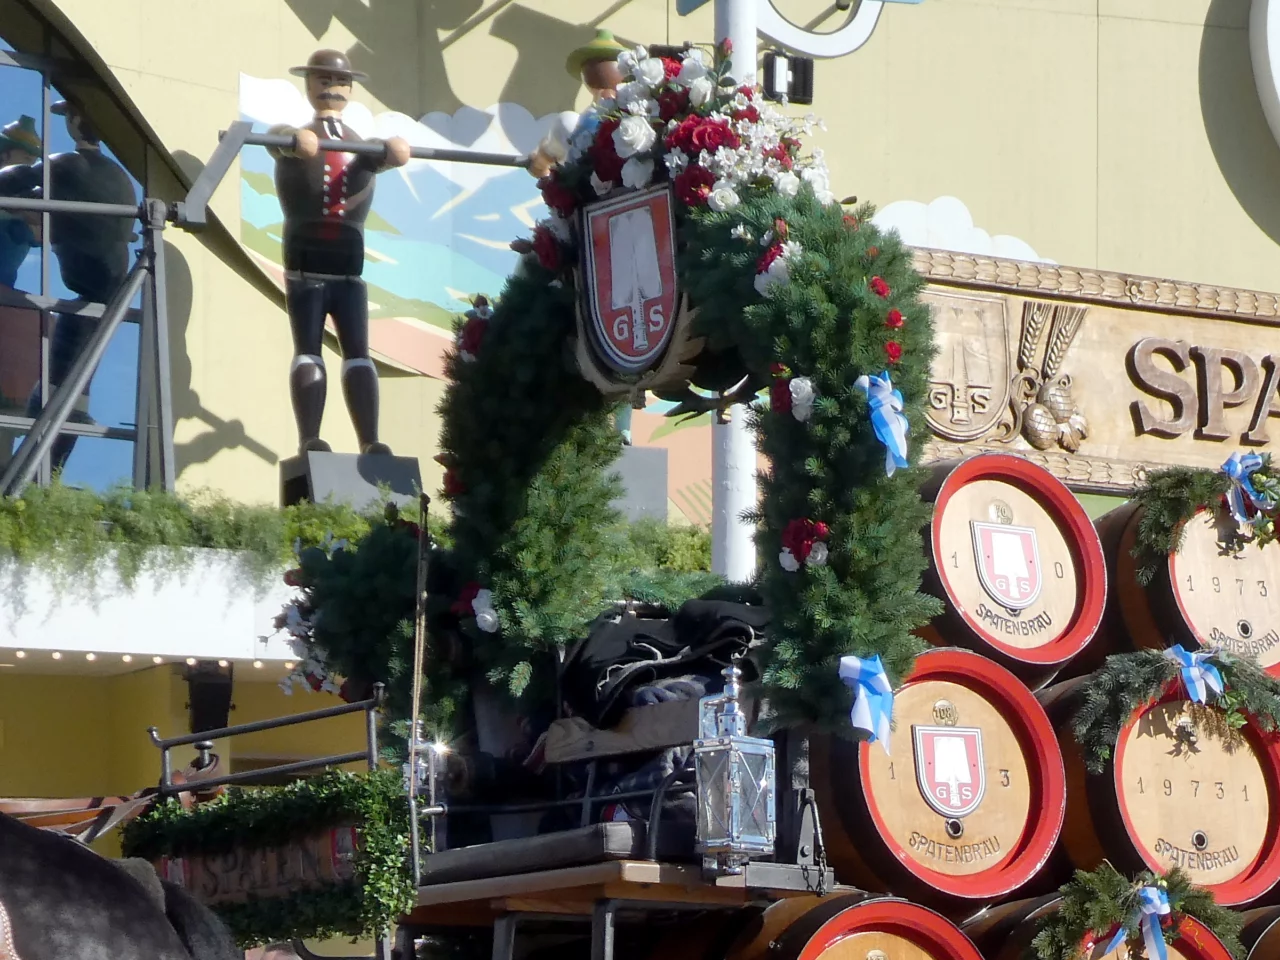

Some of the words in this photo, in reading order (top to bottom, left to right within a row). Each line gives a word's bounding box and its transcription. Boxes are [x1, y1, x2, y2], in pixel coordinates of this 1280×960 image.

[613, 314, 629, 341] G
[649, 304, 665, 333] S
[929, 387, 948, 410] G
[971, 387, 991, 414] S
[995, 577, 1006, 591] G
[1021, 580, 1031, 594] S
[888, 761, 896, 780] 1
[999, 768, 1010, 788] 3
[935, 786, 947, 799] G
[961, 786, 973, 800] S
[908, 831, 1001, 864] SPATENBRÄU
[1155, 837, 1239, 871] SPATENBRÄU
